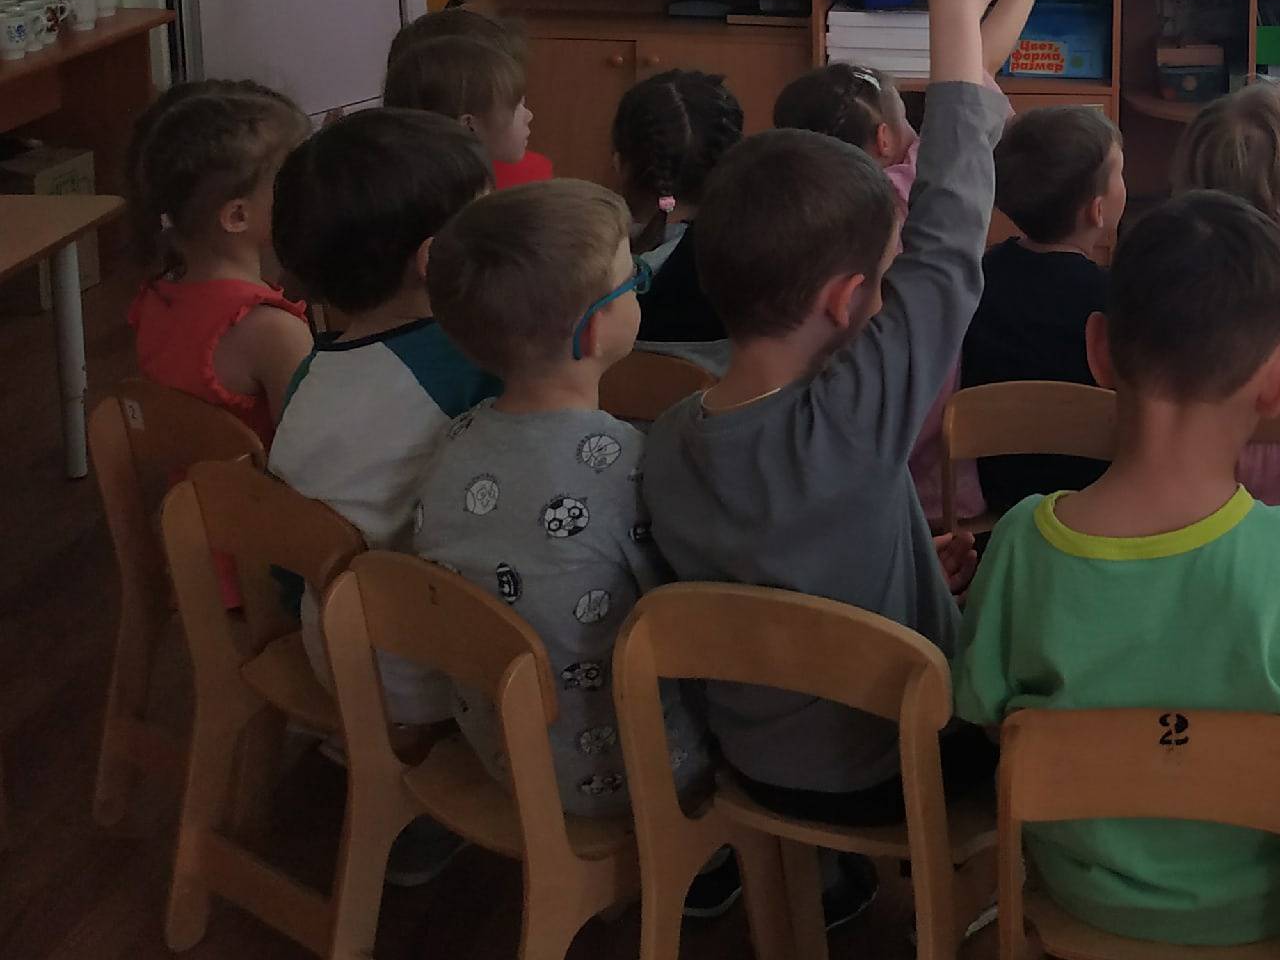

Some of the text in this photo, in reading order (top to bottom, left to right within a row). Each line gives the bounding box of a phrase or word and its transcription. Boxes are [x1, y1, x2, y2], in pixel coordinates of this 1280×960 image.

[1020, 41, 1059, 52] Цвет,
[1012, 50, 1065, 64] форма,
[1011, 62, 1064, 73] размер
[1159, 713, 1190, 746] 2
